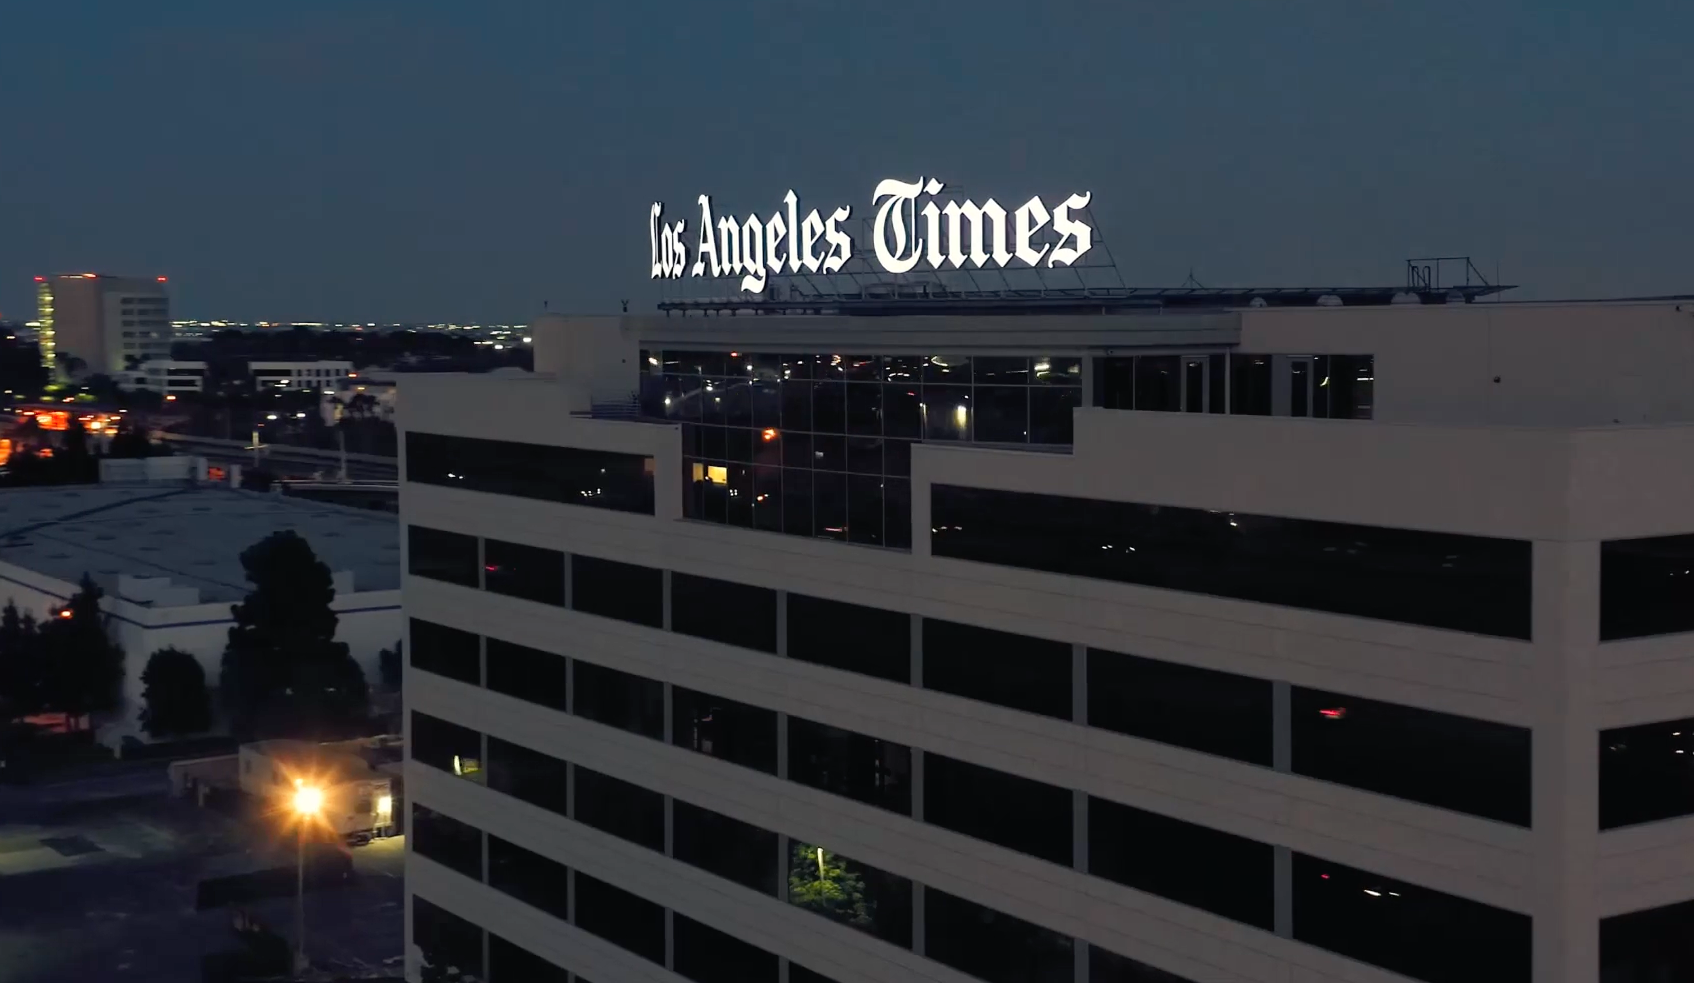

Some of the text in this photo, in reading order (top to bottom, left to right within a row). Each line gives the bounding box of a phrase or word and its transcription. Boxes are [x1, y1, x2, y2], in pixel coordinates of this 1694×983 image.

[650, 176, 1093, 294] Los Angeles Times
